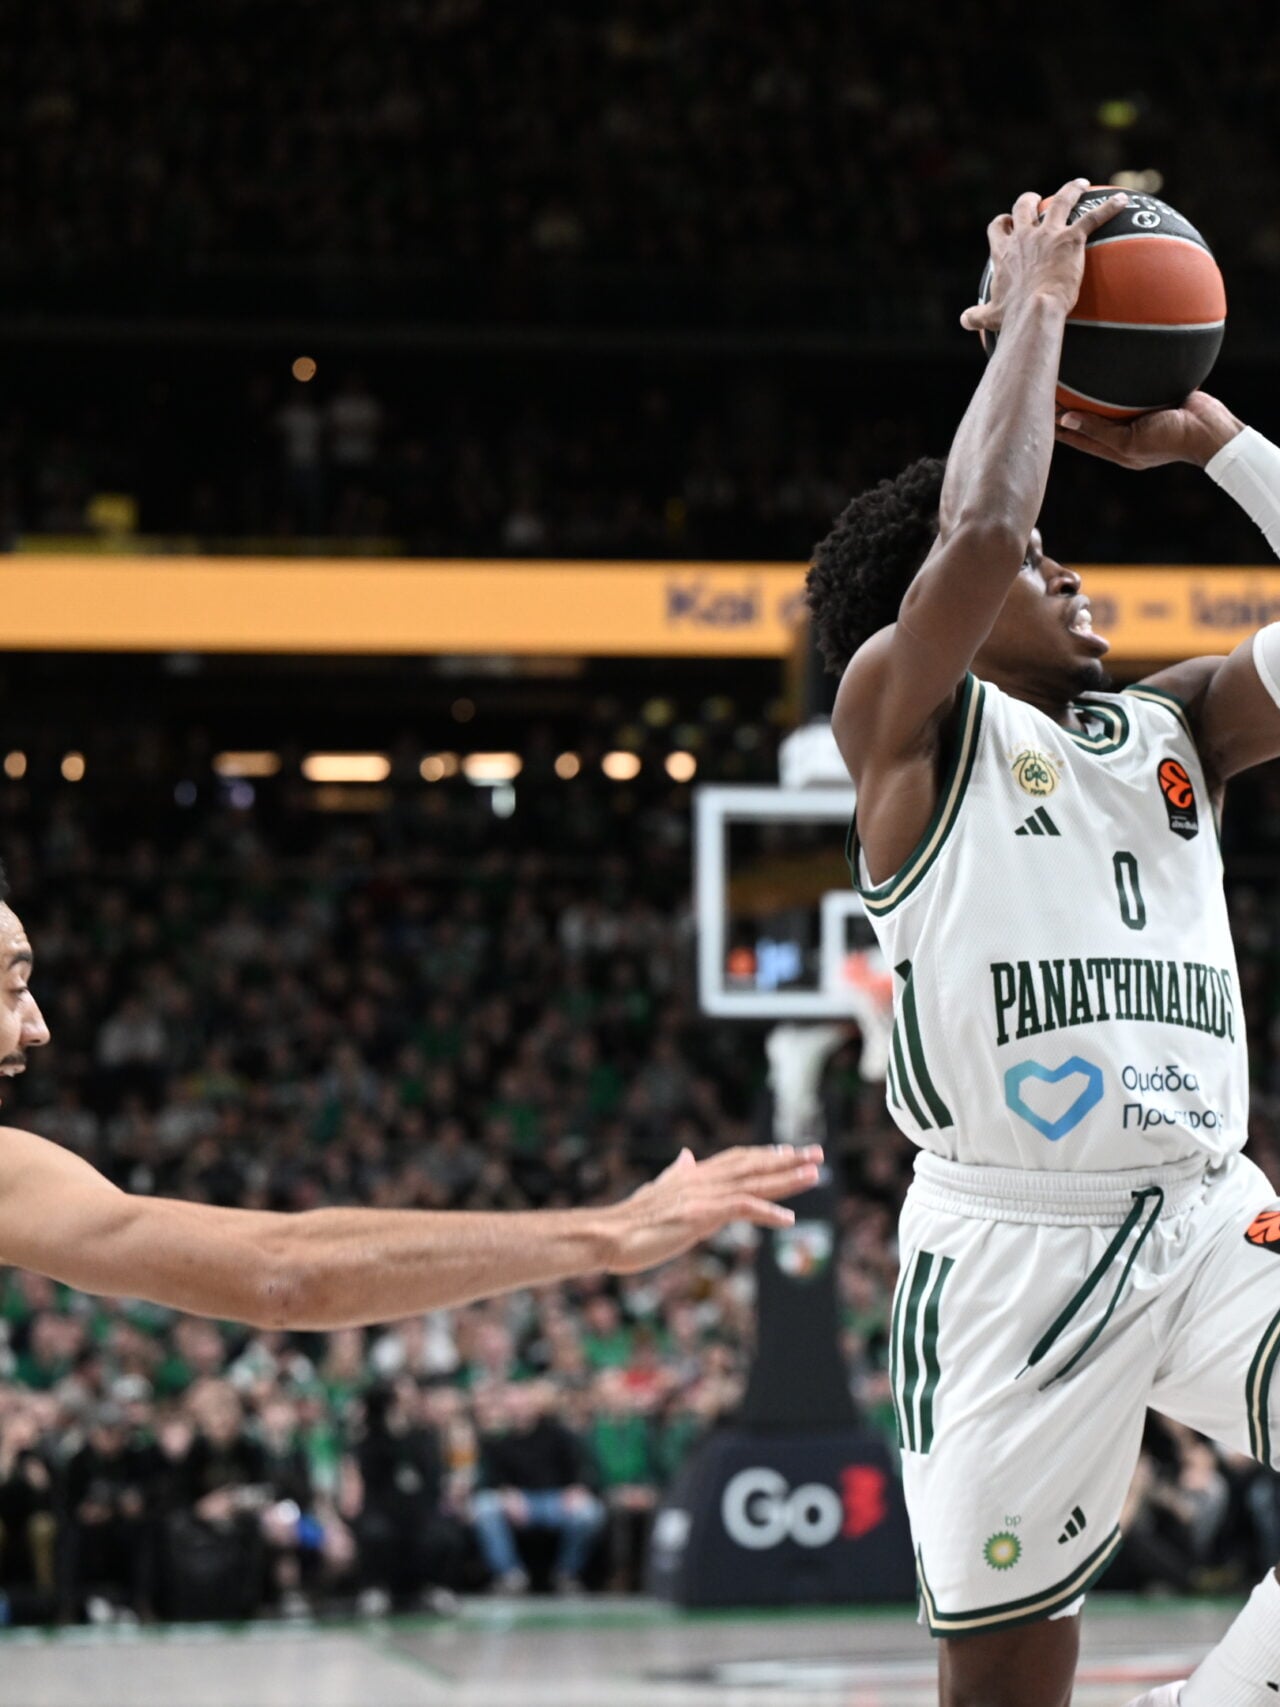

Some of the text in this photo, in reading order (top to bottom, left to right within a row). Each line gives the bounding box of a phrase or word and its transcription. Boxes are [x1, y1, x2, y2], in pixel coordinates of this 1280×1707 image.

[1112, 851, 1147, 931] 0
[1122, 1065, 1200, 1096] Ομάδα
[1004, 1514, 1022, 1528] bp
